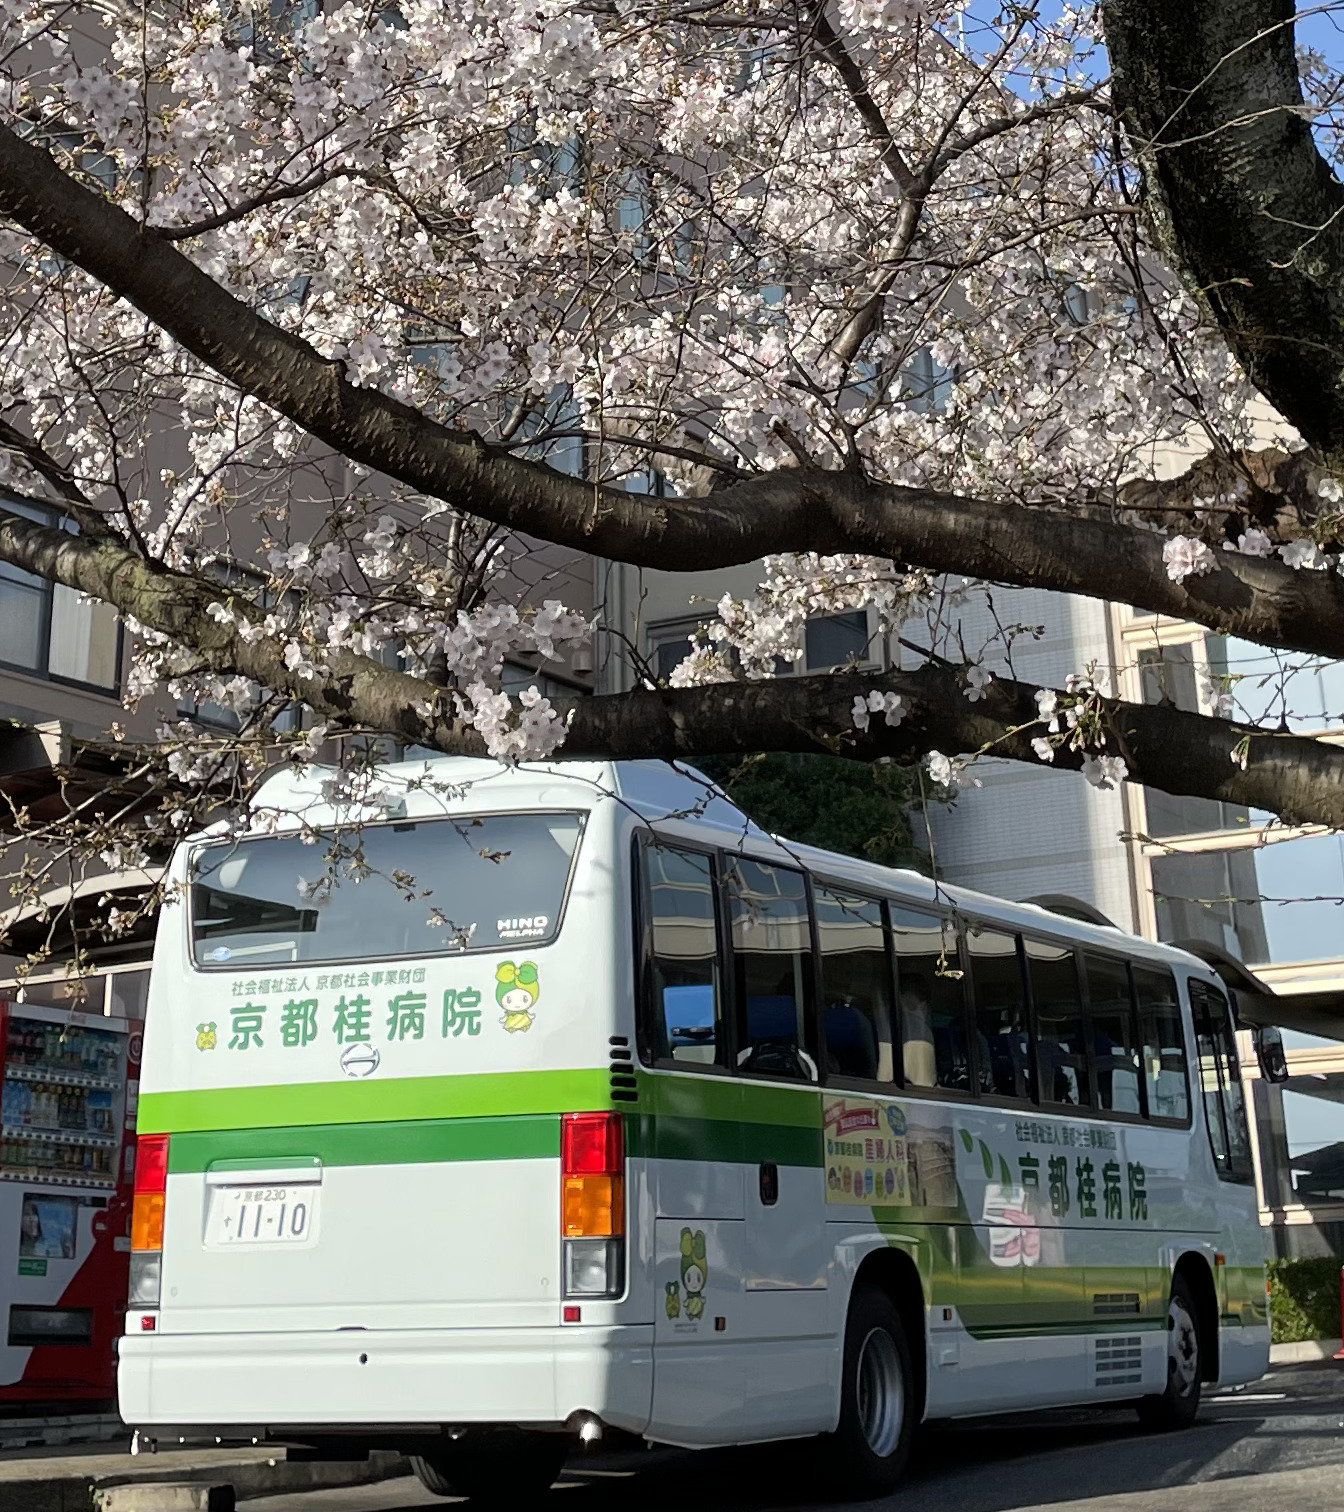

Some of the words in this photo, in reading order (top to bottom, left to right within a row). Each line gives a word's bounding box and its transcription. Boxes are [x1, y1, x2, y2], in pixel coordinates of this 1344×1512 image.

[497, 915, 548, 931] HINO
[231, 976, 311, 997] 社会福祉法人
[315, 967, 426, 991] 京都社会事業財団
[228, 986, 482, 1050] 京都桂病院
[1017, 1151, 1149, 1221] 京都桂病院
